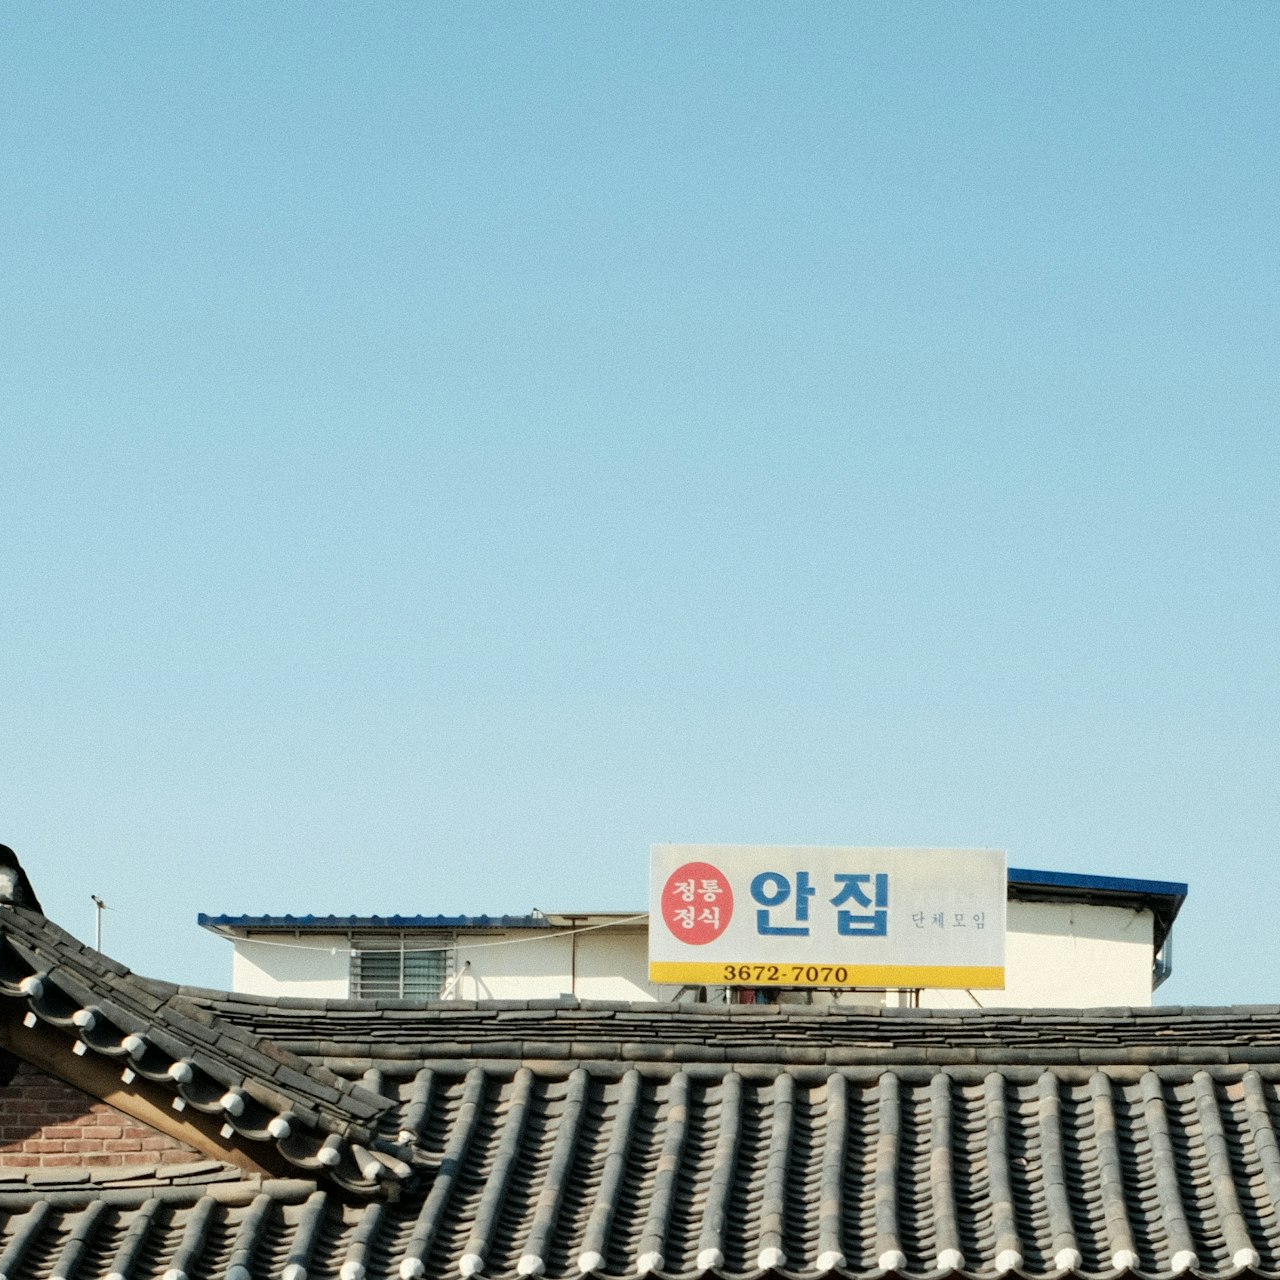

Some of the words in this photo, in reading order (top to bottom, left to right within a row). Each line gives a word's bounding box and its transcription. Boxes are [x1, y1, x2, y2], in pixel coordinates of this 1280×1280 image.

[673, 878, 723, 902] 정통
[673, 906, 721, 930] 정식
[723, 965, 848, 983] 3672-7070
